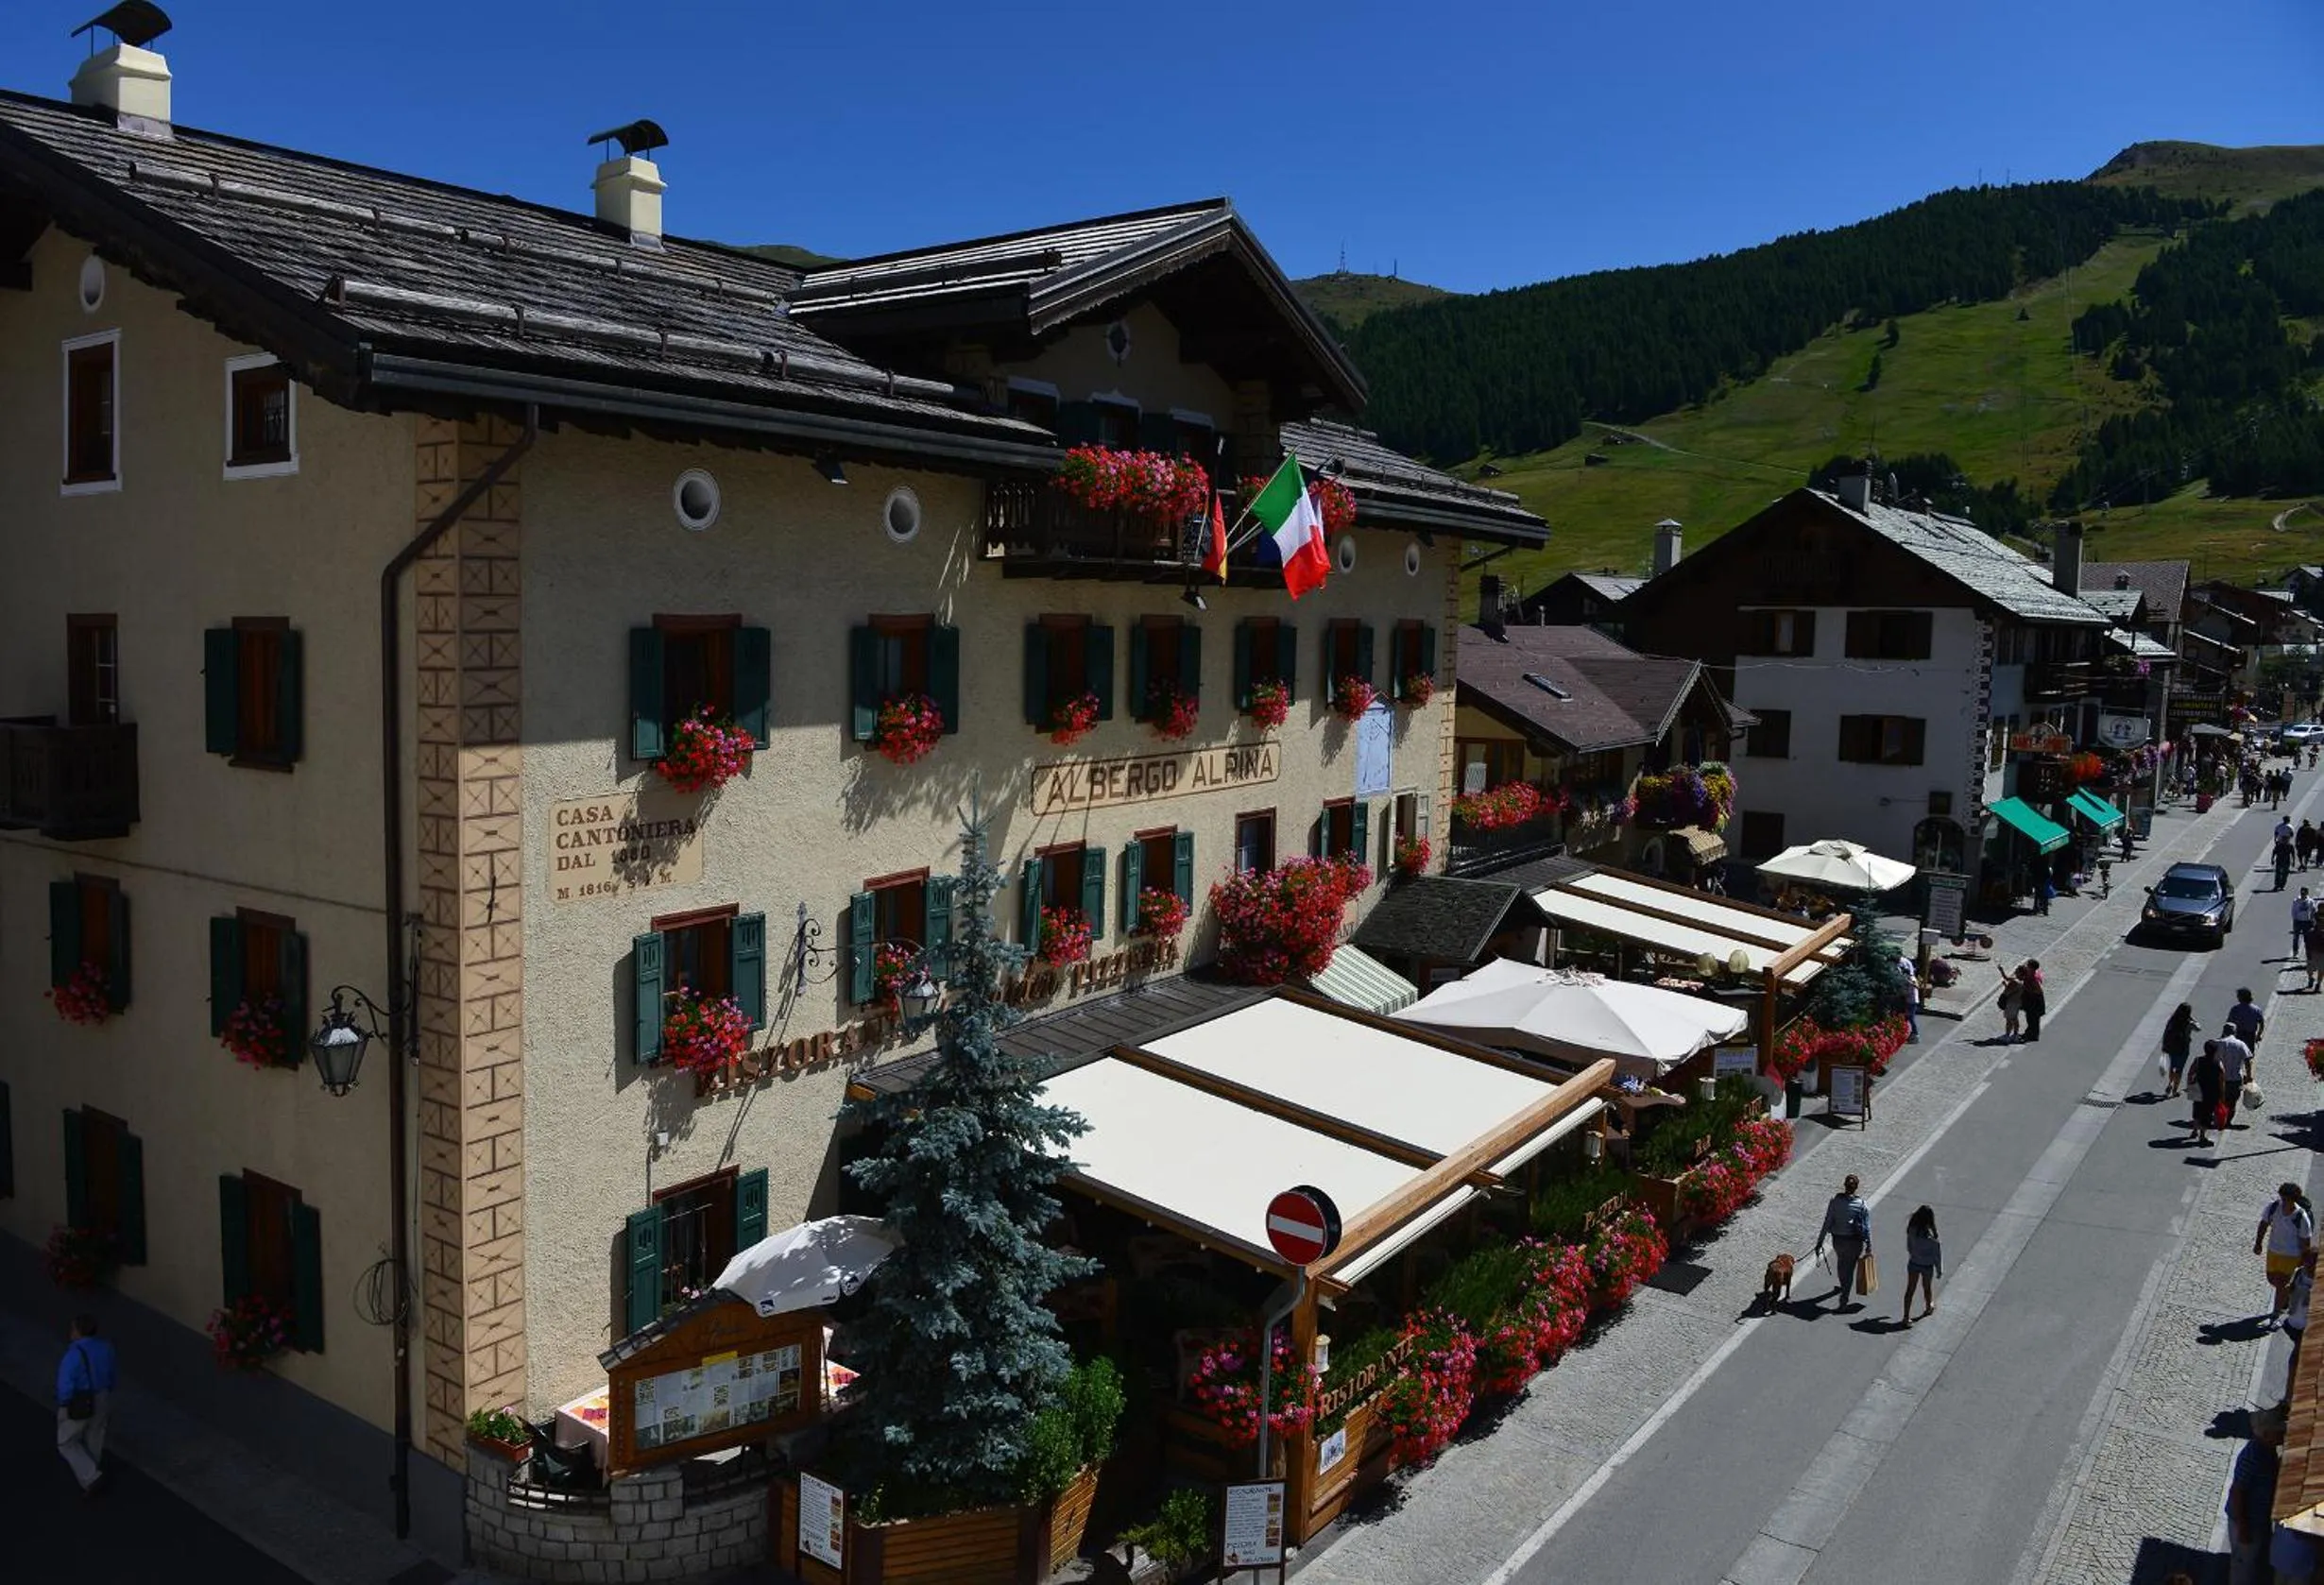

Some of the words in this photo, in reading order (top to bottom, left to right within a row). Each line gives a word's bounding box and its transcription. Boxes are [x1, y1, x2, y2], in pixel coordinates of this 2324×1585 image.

[1047, 759, 1177, 807] ALBERGO
[1191, 748, 1273, 788] ALPINA
[556, 805, 614, 827] CASA
[555, 817, 696, 850] CANTONIERA
[556, 852, 596, 872] DAL
[1318, 1334, 1415, 1420] RISTORANTE
